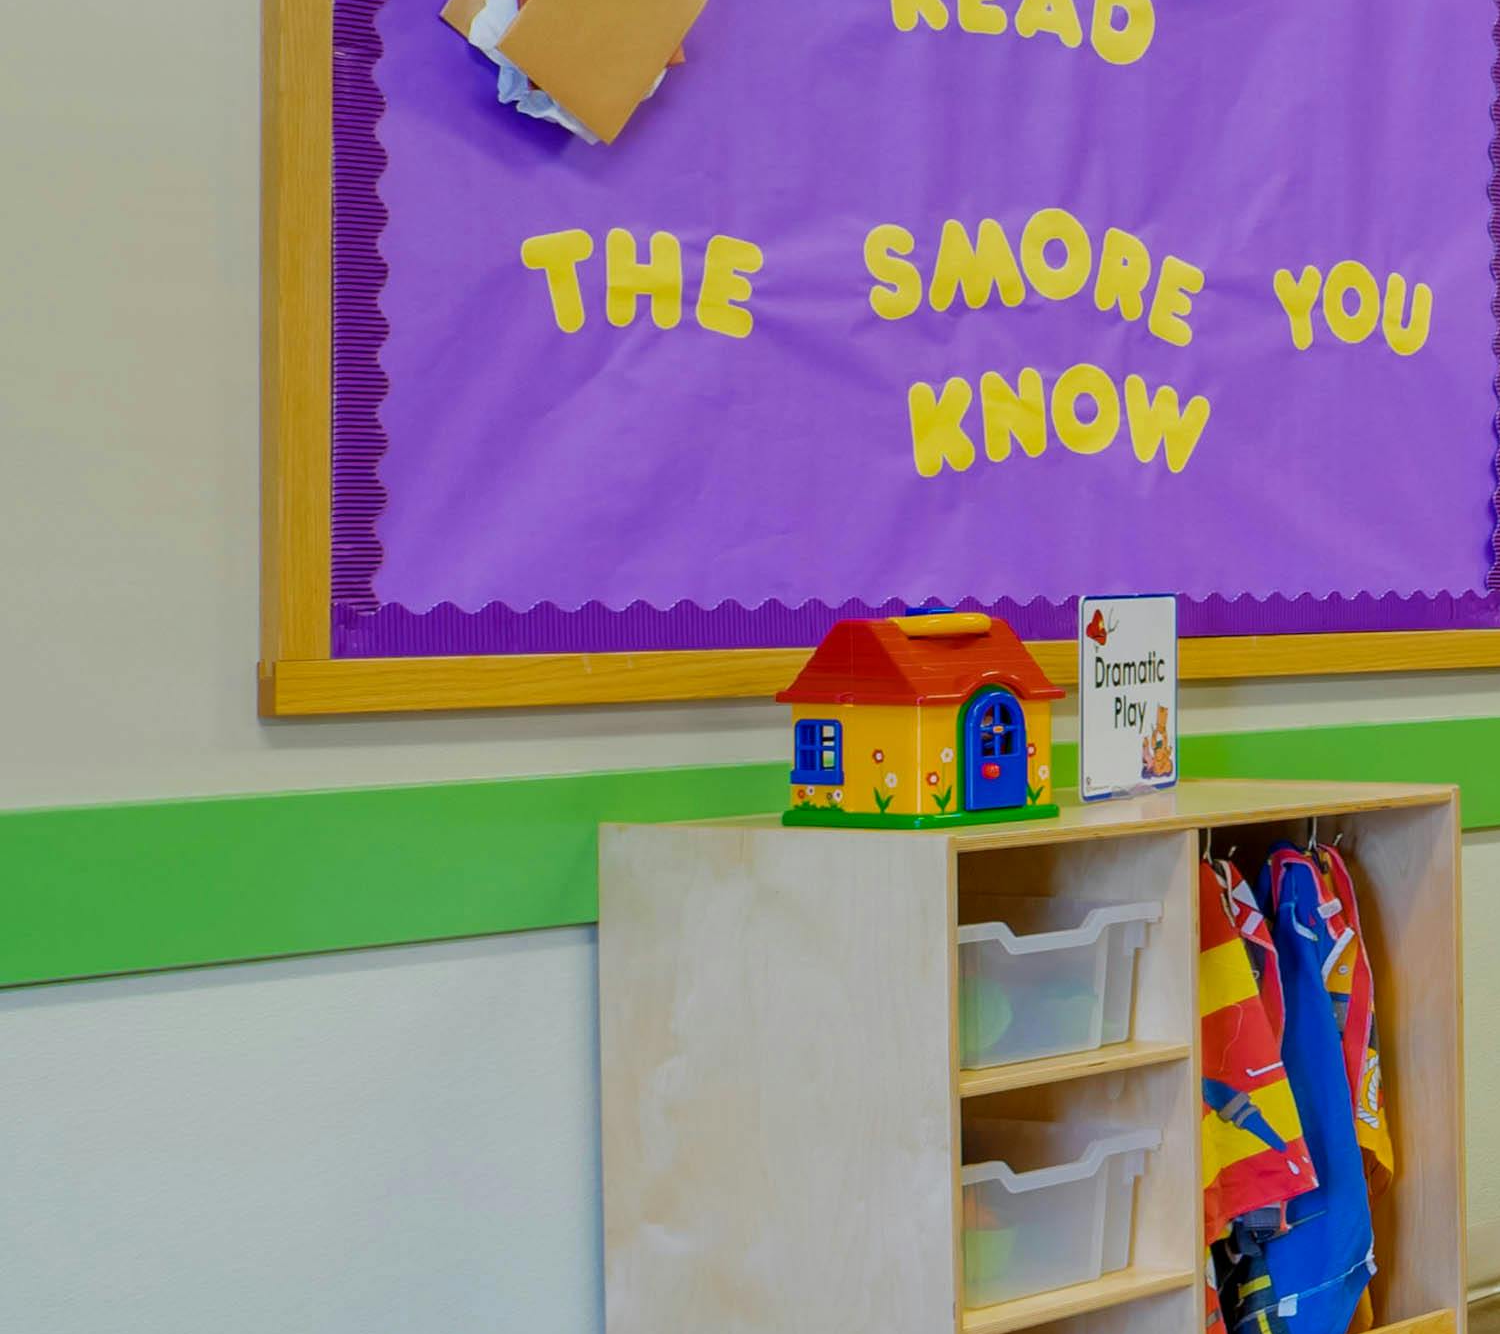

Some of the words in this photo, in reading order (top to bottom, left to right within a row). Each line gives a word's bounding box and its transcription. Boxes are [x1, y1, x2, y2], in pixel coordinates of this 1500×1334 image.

[521, 228, 763, 338] THE
[864, 208, 1205, 346] SMORE
[1273, 260, 1433, 356] YOU
[908, 363, 1210, 478] KNOW
[1094, 651, 1166, 689] Dramatic
[1114, 695, 1148, 734] Play
